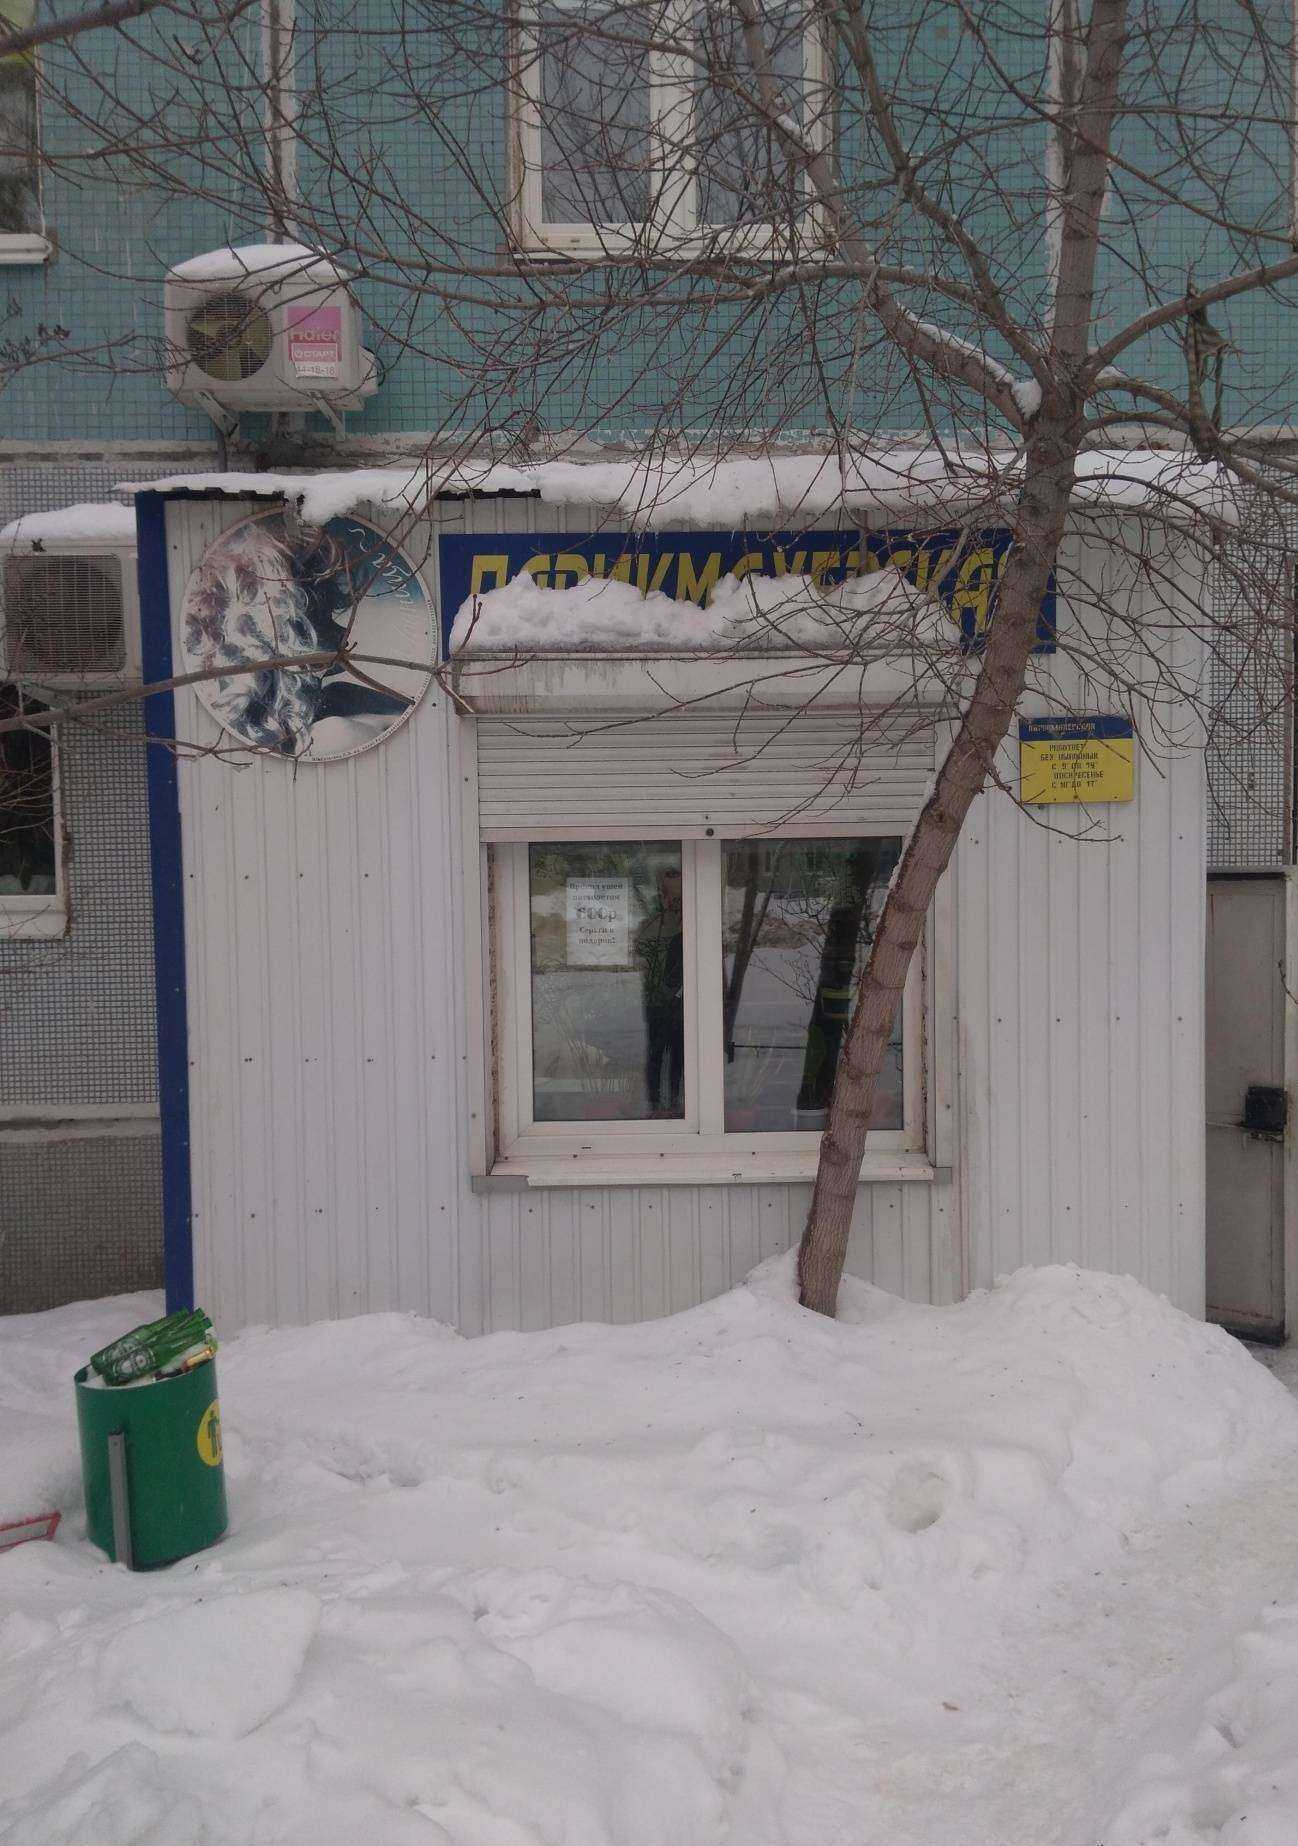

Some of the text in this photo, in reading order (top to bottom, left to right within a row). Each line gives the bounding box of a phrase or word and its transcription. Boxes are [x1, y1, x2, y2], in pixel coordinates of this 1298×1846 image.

[468, 548, 1010, 635] ПРКМЕКА
[1049, 742, 1084, 752] РАБОТАЕТ
[1040, 752, 1054, 761] БЕЗ
